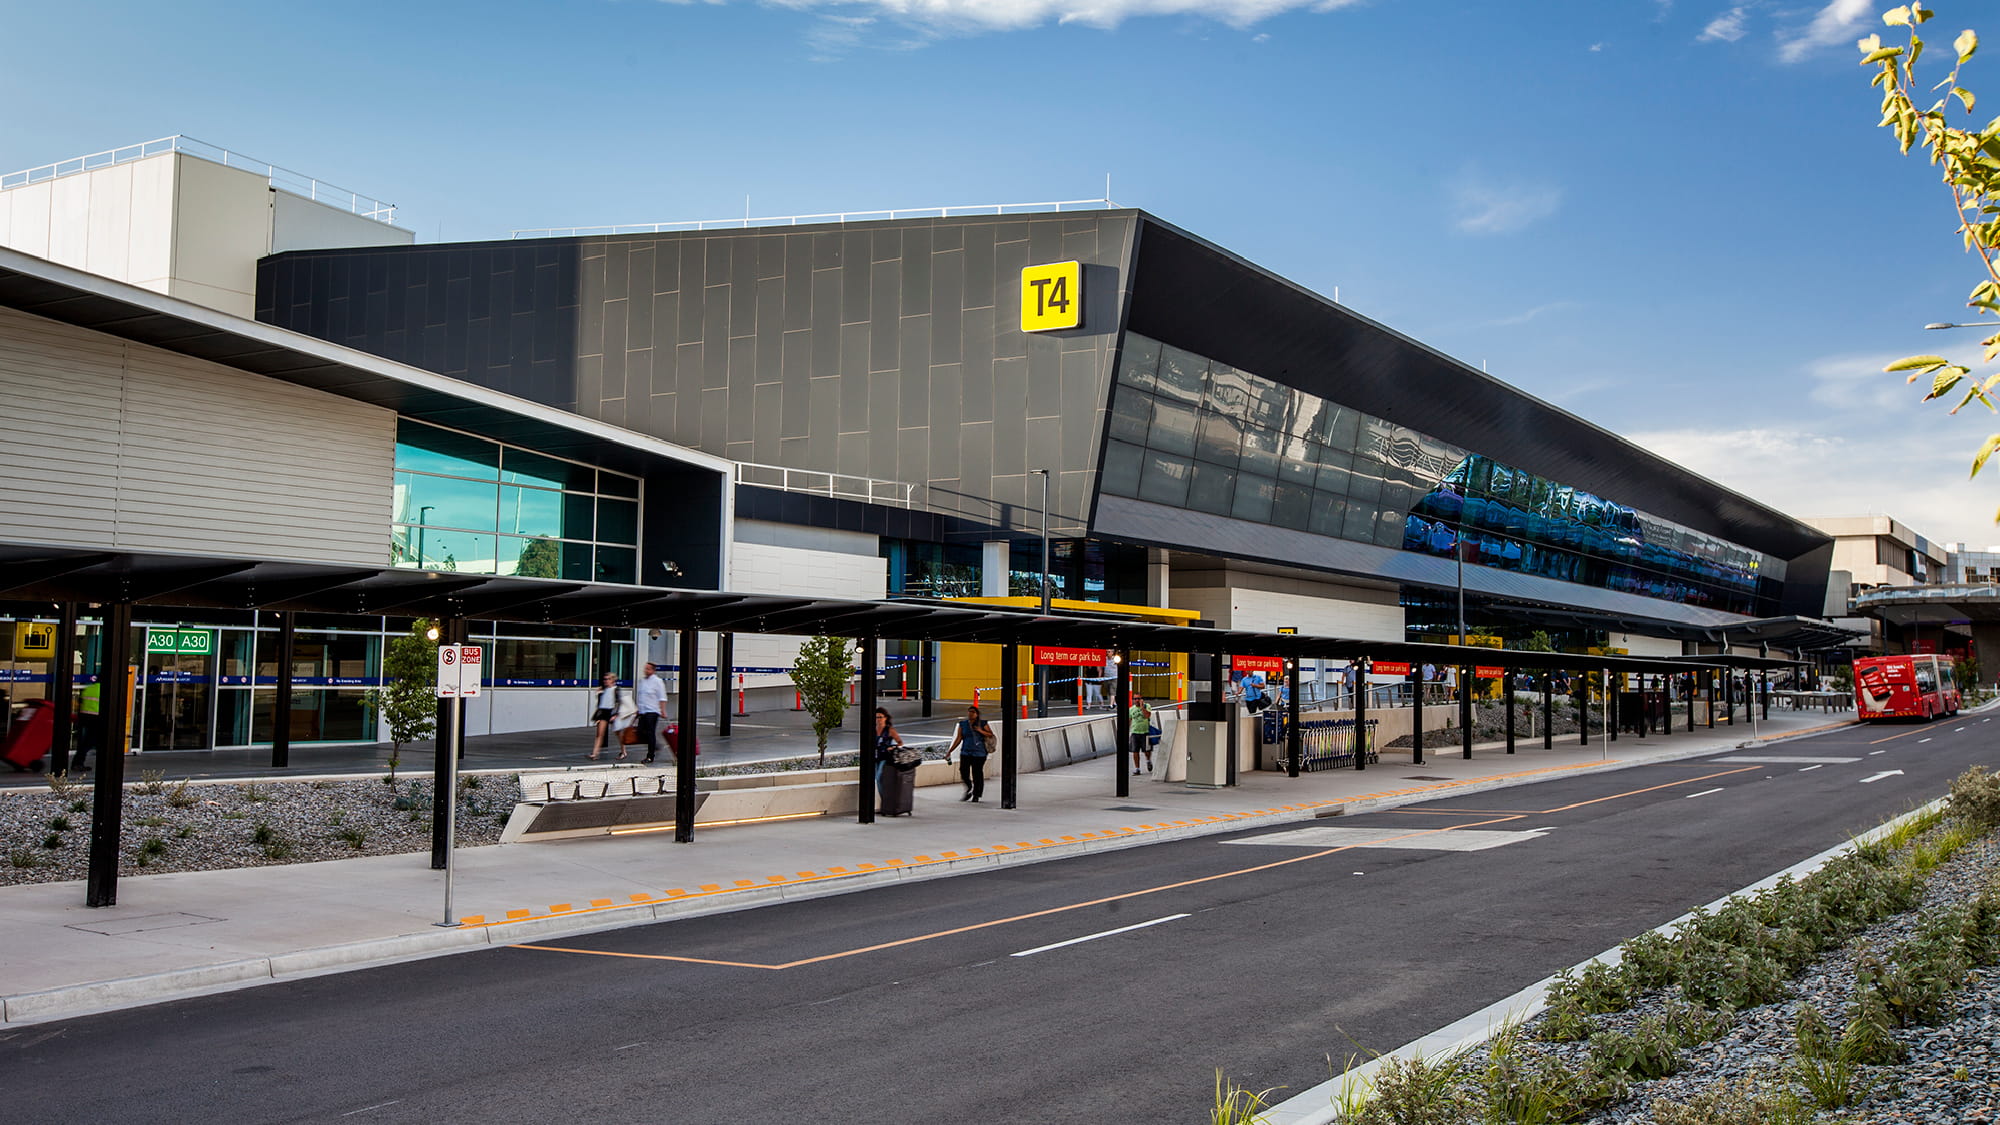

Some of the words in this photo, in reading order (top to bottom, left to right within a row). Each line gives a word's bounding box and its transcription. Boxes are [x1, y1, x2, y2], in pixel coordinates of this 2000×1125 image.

[1030, 276, 1070, 316] T4
[148, 634, 174, 646] A30
[182, 636, 206, 648] A30
[1040, 650, 1054, 662] Long
[1055, 651, 1068, 660] term
[1070, 653, 1078, 661] car
[1079, 652, 1090, 662] park
[1092, 652, 1100, 661] bus
[1236, 658, 1246, 668] Long
[1263, 660, 1272, 669] park
